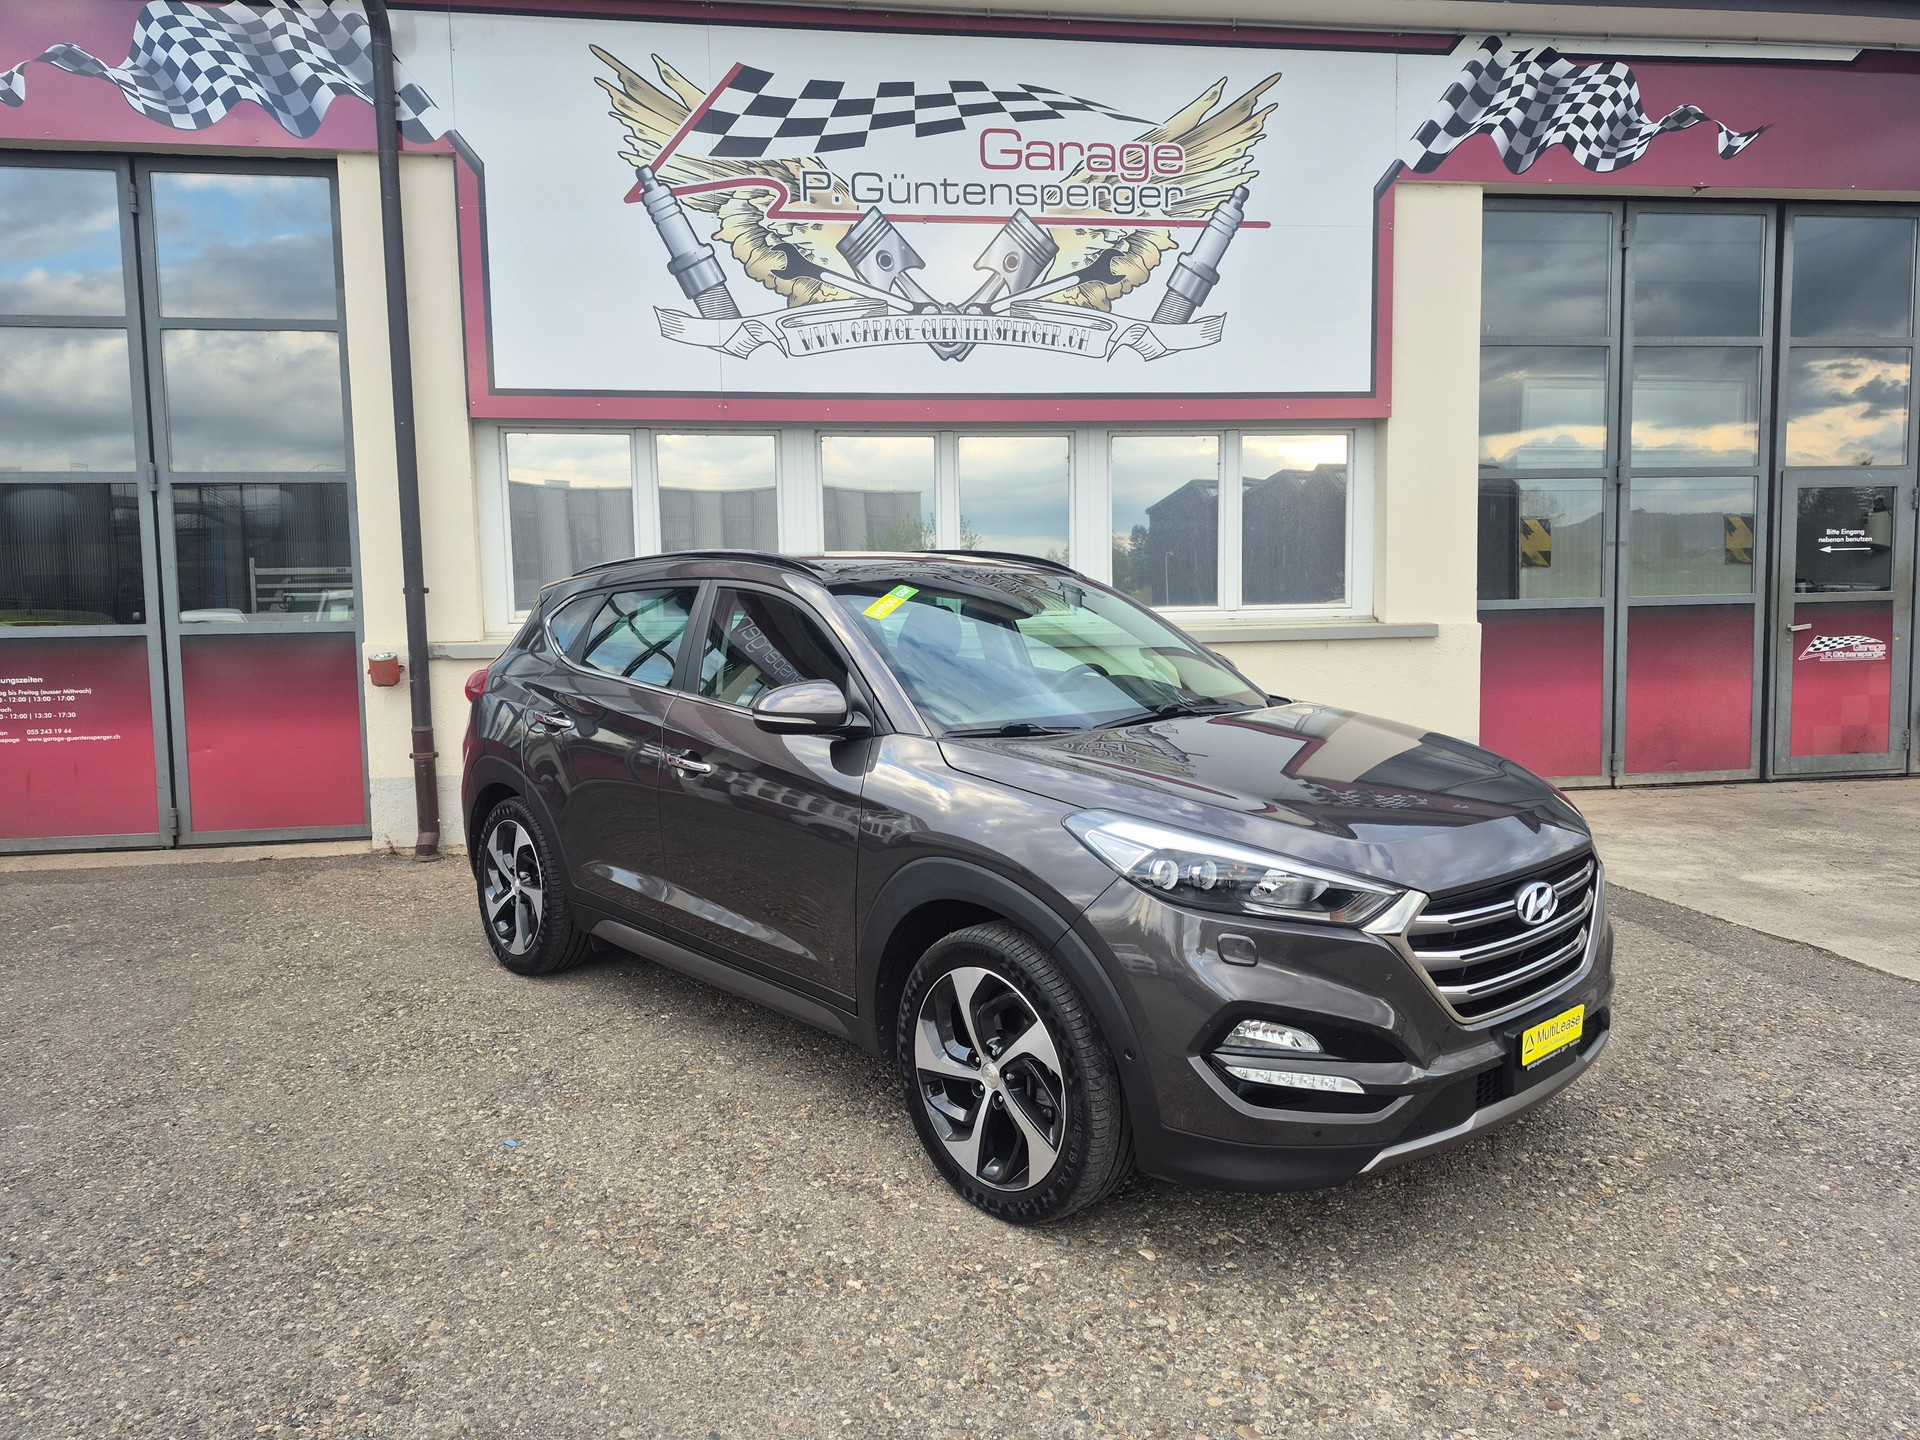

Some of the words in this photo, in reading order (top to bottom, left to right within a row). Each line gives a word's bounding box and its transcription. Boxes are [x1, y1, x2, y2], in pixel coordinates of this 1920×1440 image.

[979, 128, 1184, 183] Garage
[802, 171, 841, 203] P.
[851, 171, 1184, 214] Güntensperger
[797, 317, 1091, 352] WWW.GARAGE-GUENTENSPERGER.CH
[1841, 528, 1865, 536] Eingang
[0, 676, 43, 686] ungszeiten
[18, 689, 39, 697] Freitag
[62, 687, 92, 695] Mittwoch)
[1536, 1014, 1581, 1043] MultiLease
